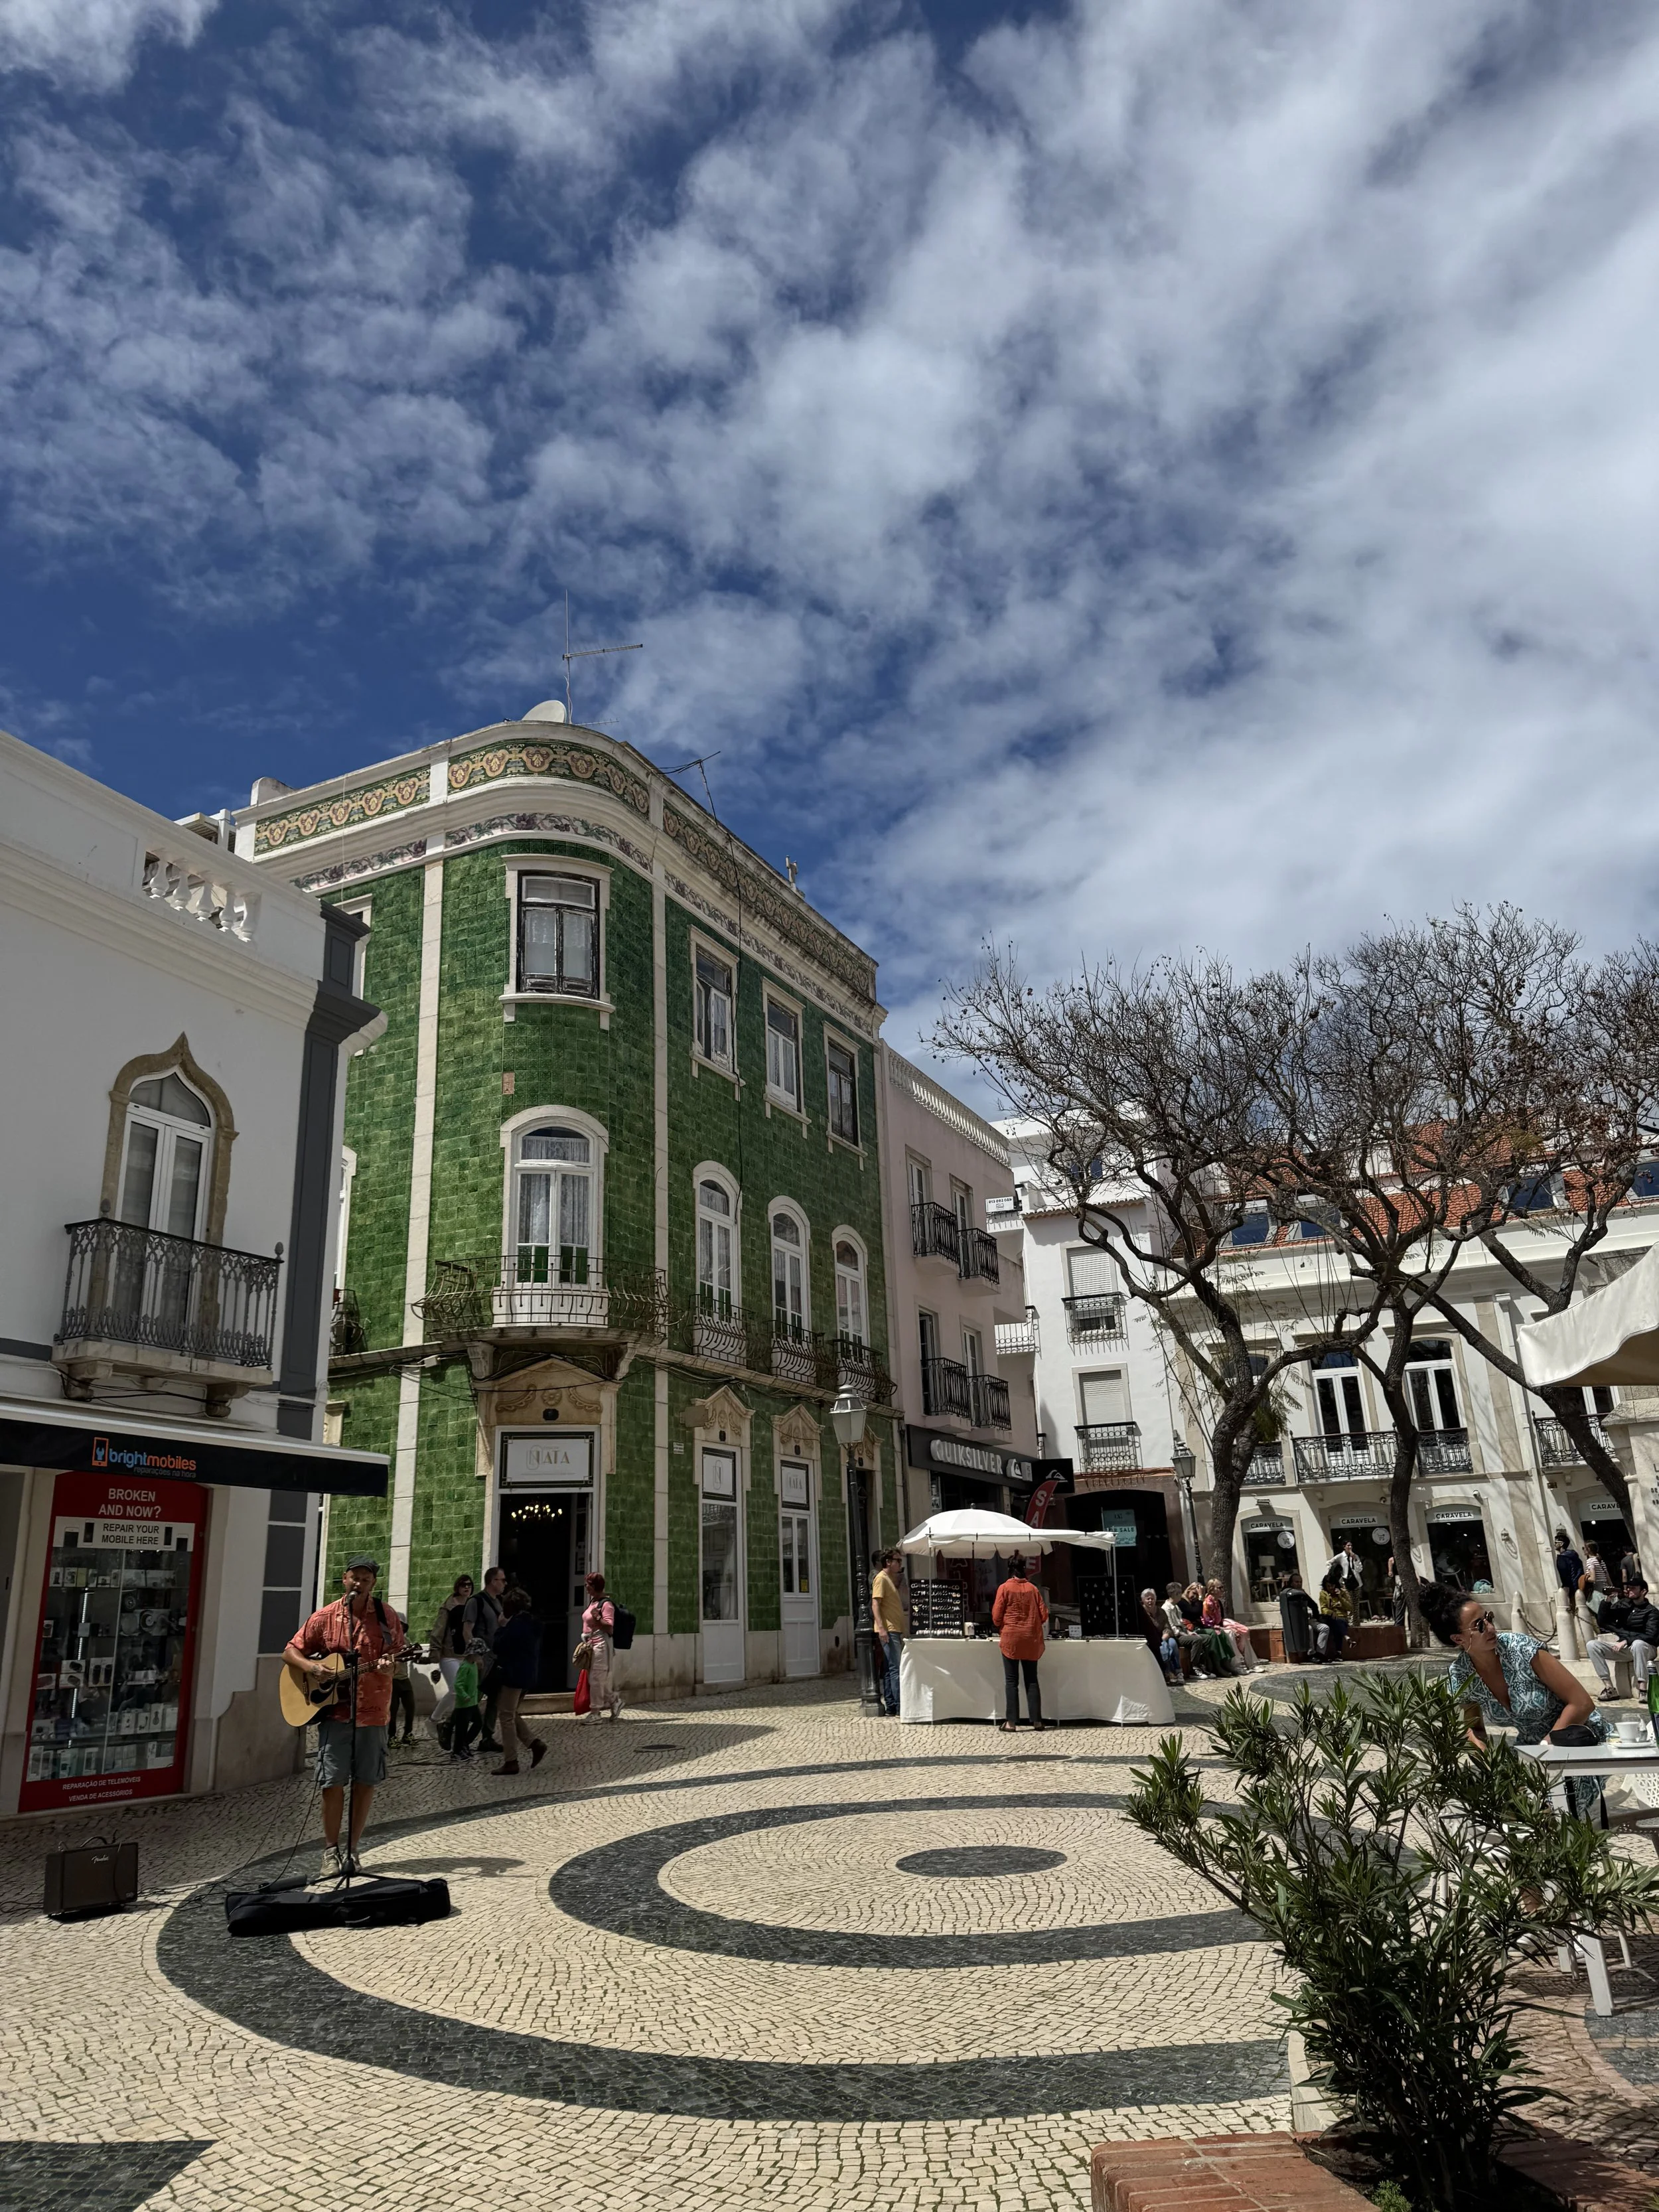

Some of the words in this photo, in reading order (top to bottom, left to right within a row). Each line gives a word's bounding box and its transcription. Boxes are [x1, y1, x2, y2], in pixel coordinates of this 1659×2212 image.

[109, 1448, 197, 1471] brightmobiles
[528, 1449, 570, 1465] NATA
[930, 1439, 1003, 1475] QUIKSILVER
[108, 1488, 156, 1502] BROKEN
[98, 1504, 123, 1516] AND
[126, 1505, 162, 1518] NOW?
[103, 1523, 134, 1532] REPAIR
[136, 1524, 159, 1534] YOUR
[1025, 1490, 1047, 1570] SAE
[102, 1534, 134, 1544] MOBILE
[136, 1536, 159, 1545] HERE
[62, 1781, 98, 1791] REPARAÇÃO
[108, 1776, 141, 1785] TELEMÓVEIS
[68, 1793, 88, 1802] VENDA
[98, 1789, 133, 1799] ACESSÓRIOS
